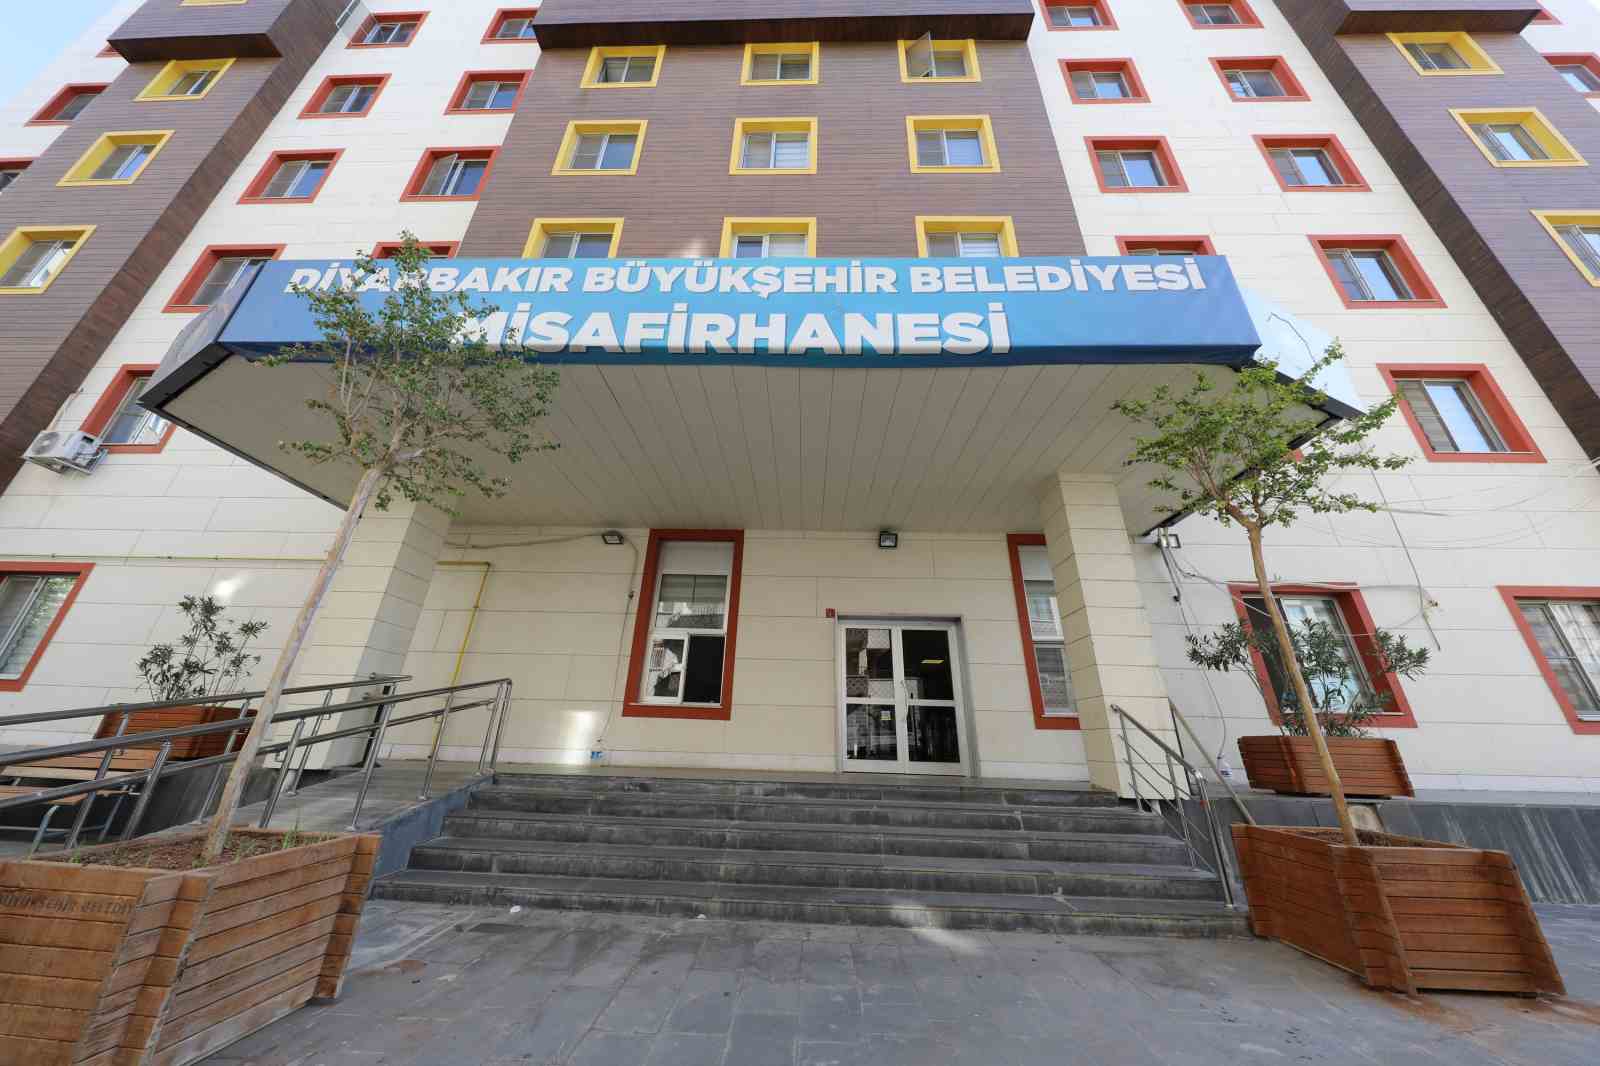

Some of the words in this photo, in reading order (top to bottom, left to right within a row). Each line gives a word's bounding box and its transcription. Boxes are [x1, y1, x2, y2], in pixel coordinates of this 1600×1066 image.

[582, 259, 899, 300] BÜYÜKŞEHİR
[909, 257, 1207, 293] BELEDİYESİ
[448, 302, 1012, 355] MİSAFİRHANESİ
